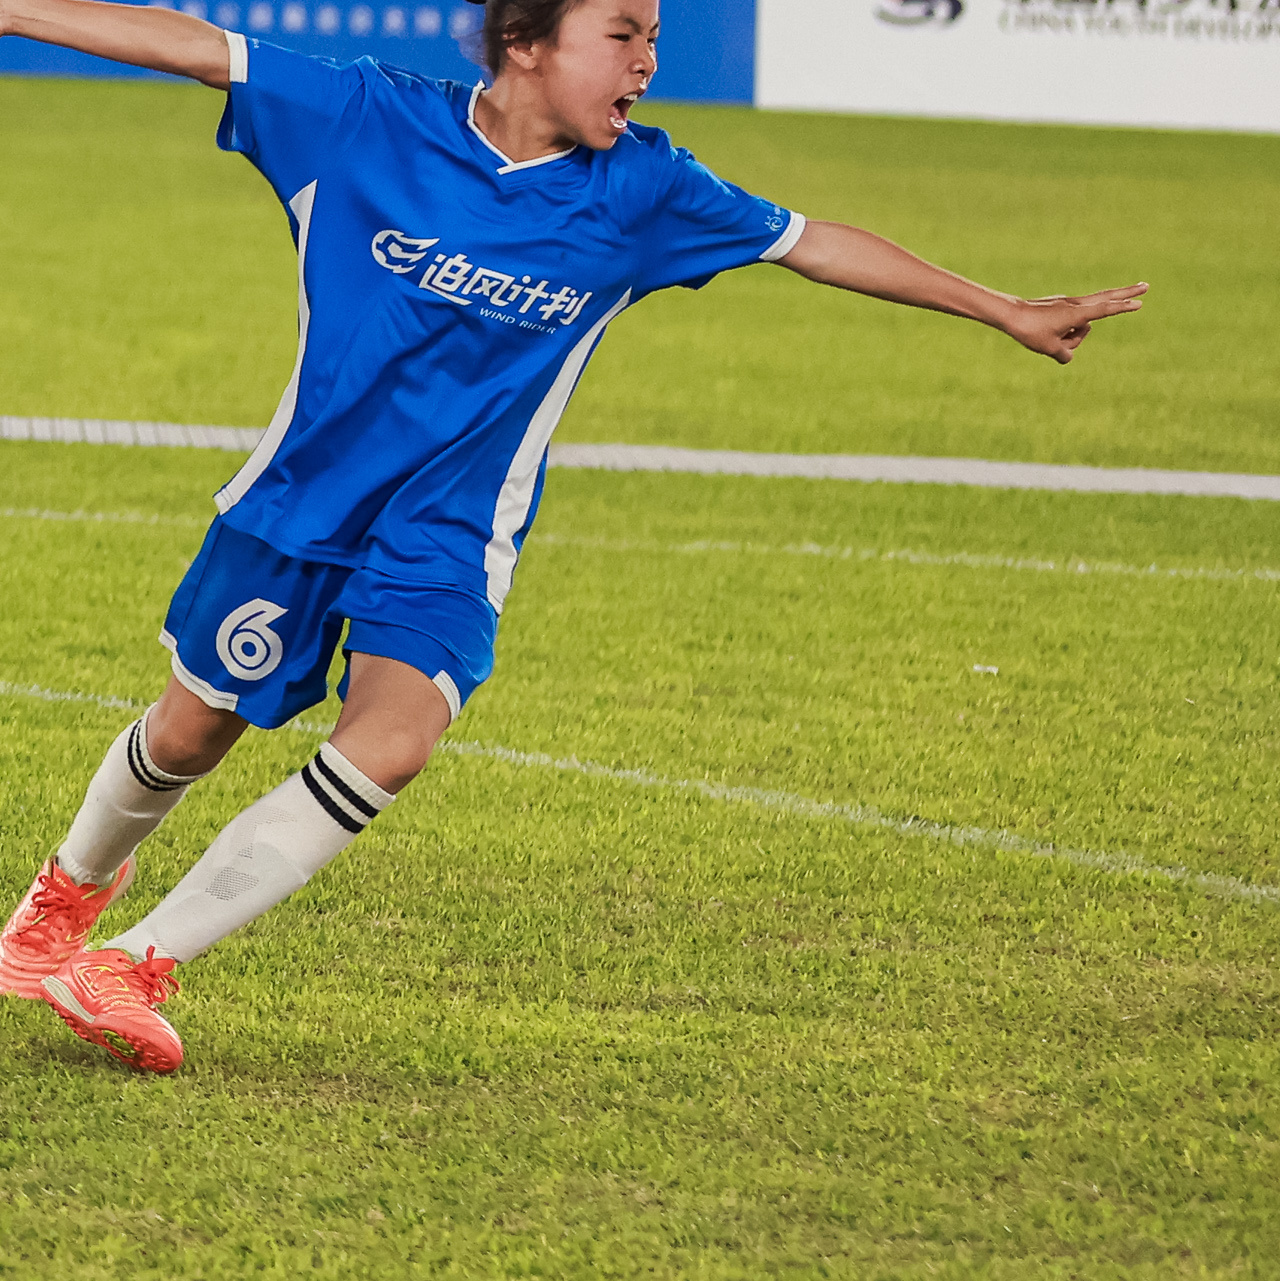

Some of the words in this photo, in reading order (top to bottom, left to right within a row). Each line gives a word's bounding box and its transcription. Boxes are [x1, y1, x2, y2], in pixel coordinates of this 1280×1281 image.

[418, 253, 593, 326] 追风计划
[478, 306, 516, 325] WIND
[519, 319, 557, 335] RIDER
[215, 597, 290, 682] 6
